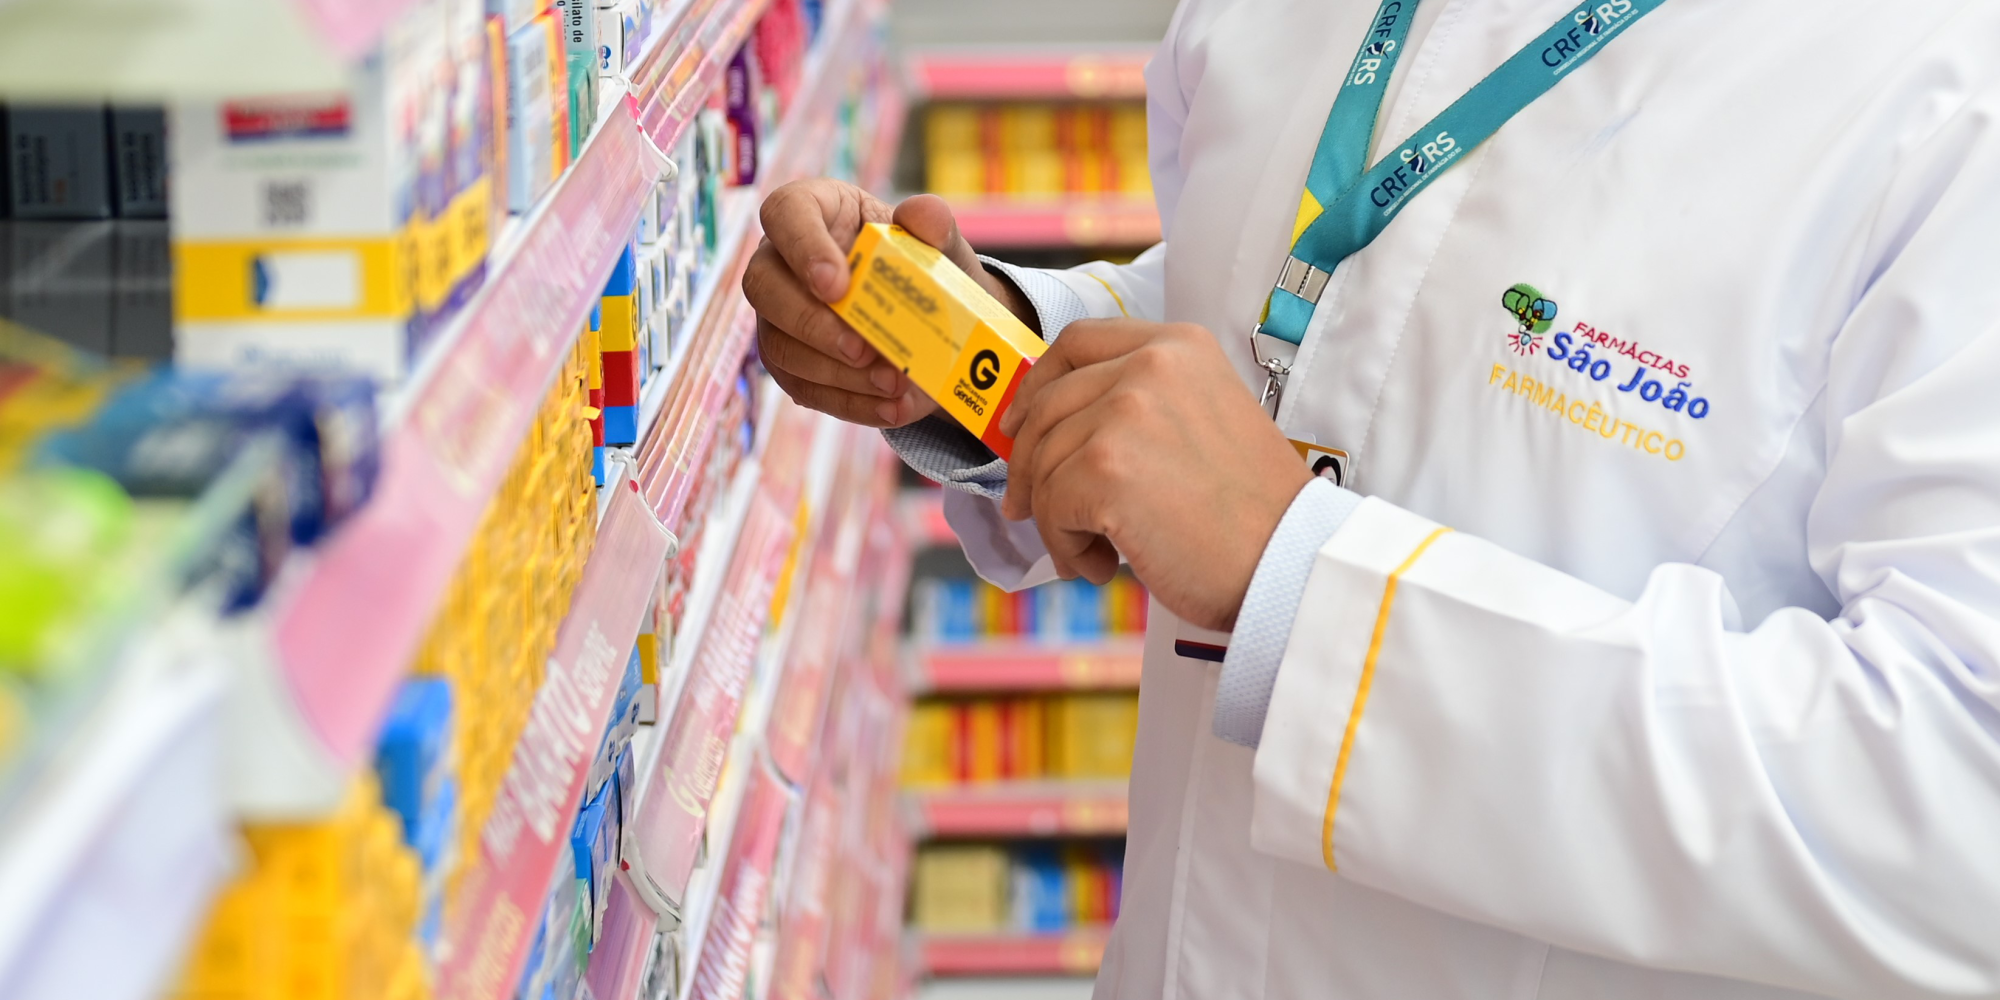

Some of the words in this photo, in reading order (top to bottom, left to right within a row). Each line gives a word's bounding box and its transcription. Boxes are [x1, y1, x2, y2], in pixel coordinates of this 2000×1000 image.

[1375, 1, 1402, 38] CRF
[1541, 27, 1582, 67] CRF
[1370, 166, 1408, 208] CRF
[1421, 131, 1456, 163] RS
[969, 349, 1000, 391] G
[1573, 322, 1691, 379] FARMÁCIAS
[958, 378, 988, 406] Medicamento
[1547, 331, 1612, 382] São
[1617, 366, 1710, 419] João
[953, 384, 984, 417] Genérico
[1489, 362, 1685, 461] FARMACÊUTICO
